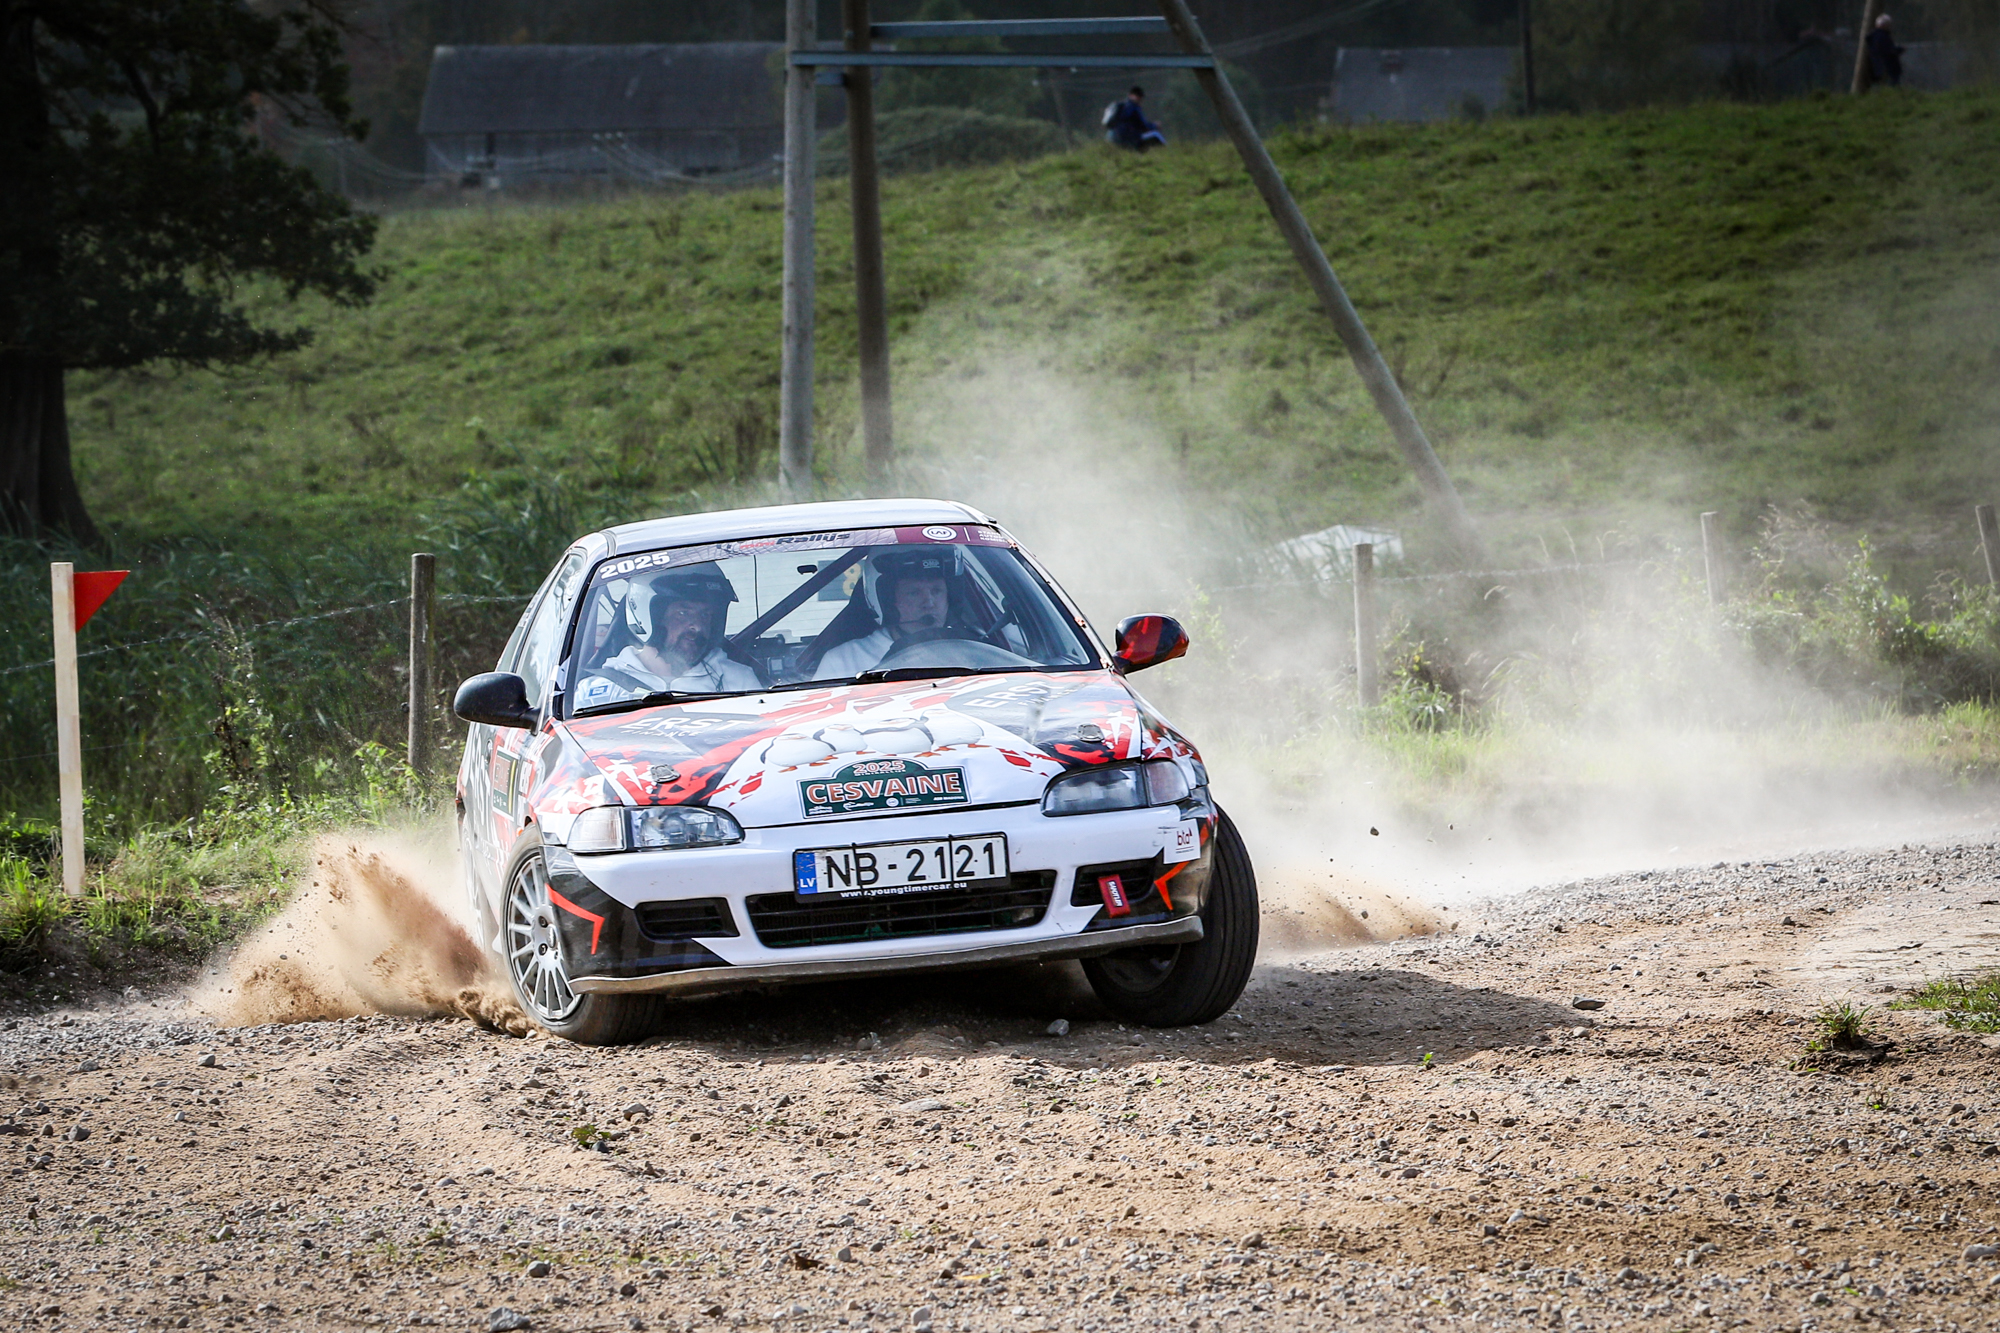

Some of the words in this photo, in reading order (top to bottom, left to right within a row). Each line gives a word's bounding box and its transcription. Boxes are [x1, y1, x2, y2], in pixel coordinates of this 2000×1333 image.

[600, 552, 670, 580] 2025
[962, 681, 1066, 709] ERST
[618, 717, 756, 731] ERST
[852, 761, 906, 774] 2025
[806, 773, 963, 805] CESVAINE
[826, 842, 996, 889] NB-2121
[800, 877, 816, 889] LV
[840, 882, 968, 898] www.youngtimercareu
